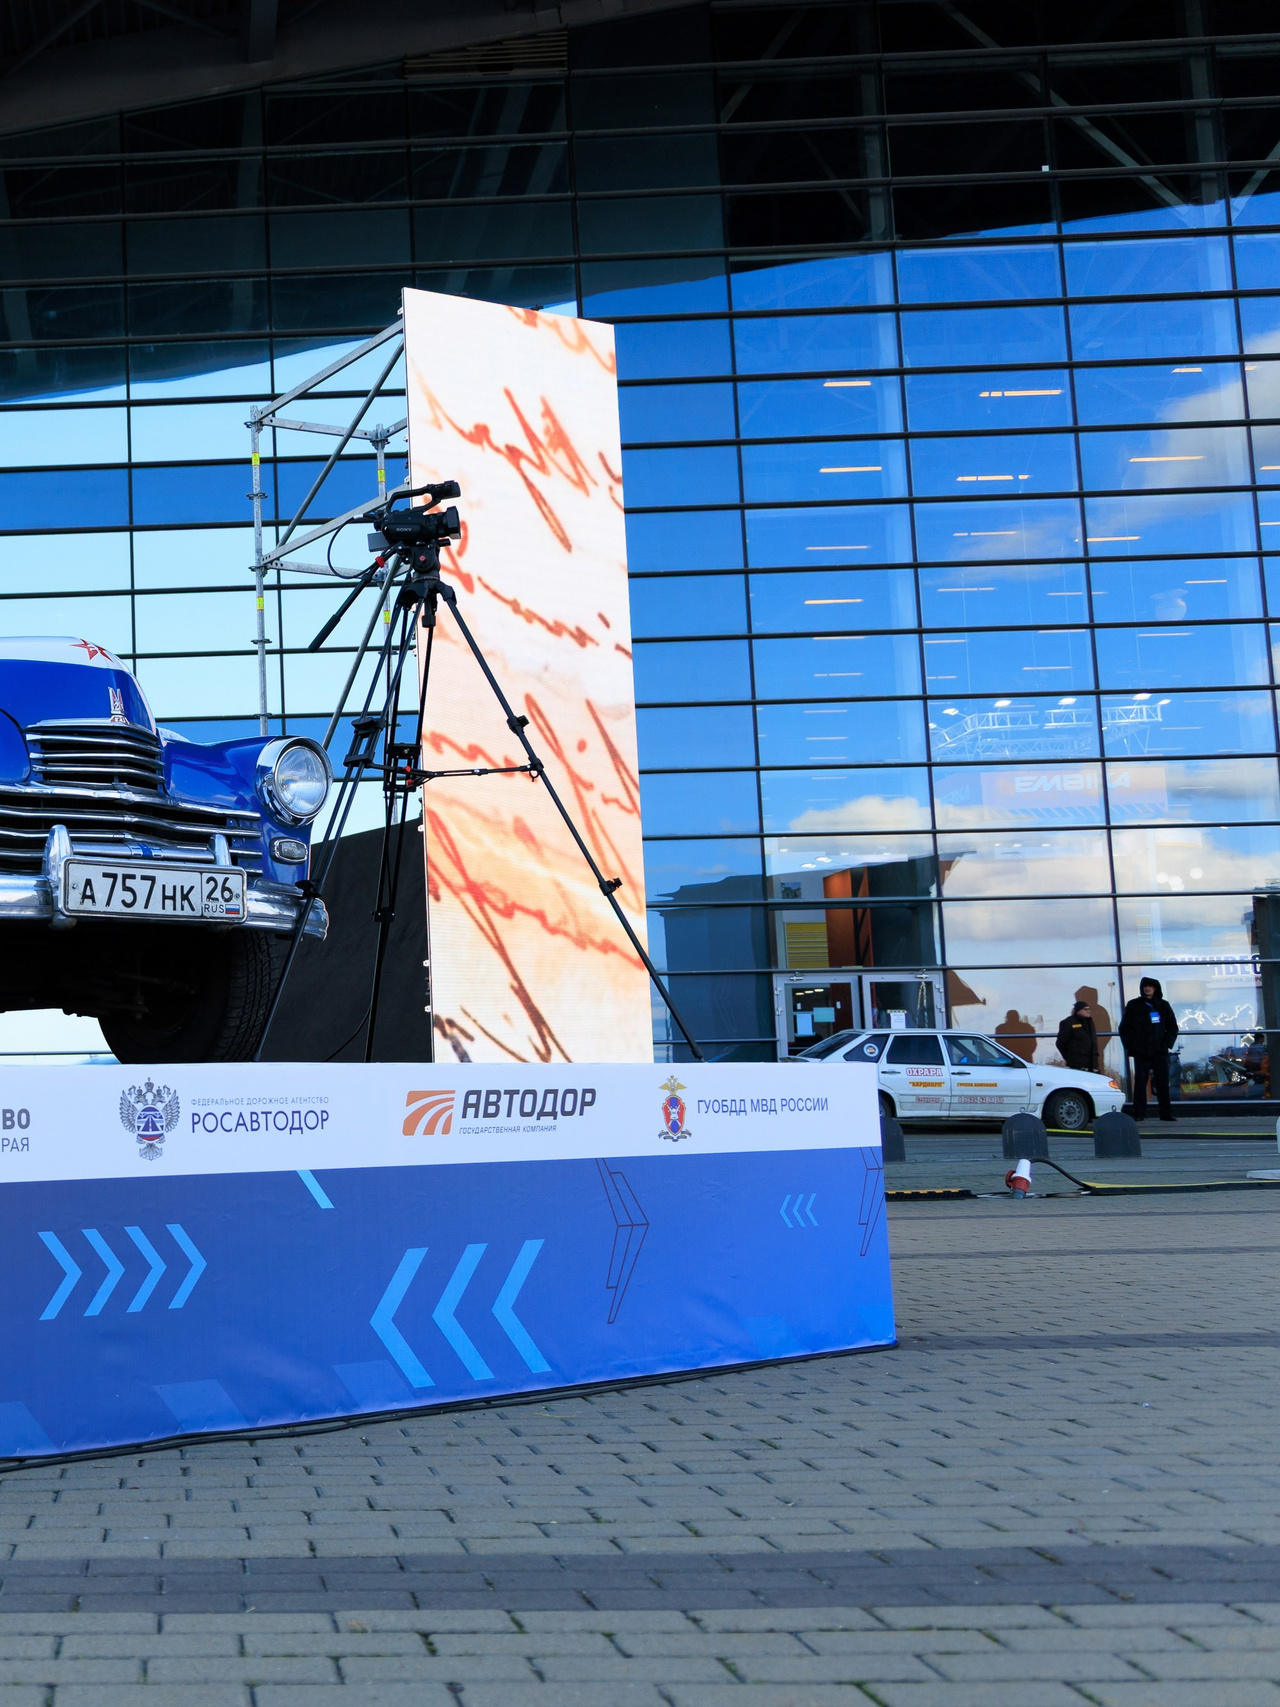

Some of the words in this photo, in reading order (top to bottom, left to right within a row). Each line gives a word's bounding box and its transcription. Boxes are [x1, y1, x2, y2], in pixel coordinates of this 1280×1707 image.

[206, 876, 233, 903] 26
[203, 904, 225, 914] RUS
[191, 1098, 244, 1106] ФЕДЕРАЛЬНОЕ
[247, 1097, 288, 1106] ДОРОЖНОЕ
[291, 1096, 329, 1104] АГЕНТСТВО
[461, 1088, 597, 1120] АВТОДОР
[697, 1099, 748, 1116] ГУОБДД
[750, 1098, 778, 1115] МВД
[780, 1097, 829, 1112] РОССИИ
[191, 1110, 329, 1134] РОСАВТОДОР
[460, 1125, 521, 1135] ГОСУДАРСТВЕННАЯ
[523, 1124, 557, 1133] КОМПАНИЯ
